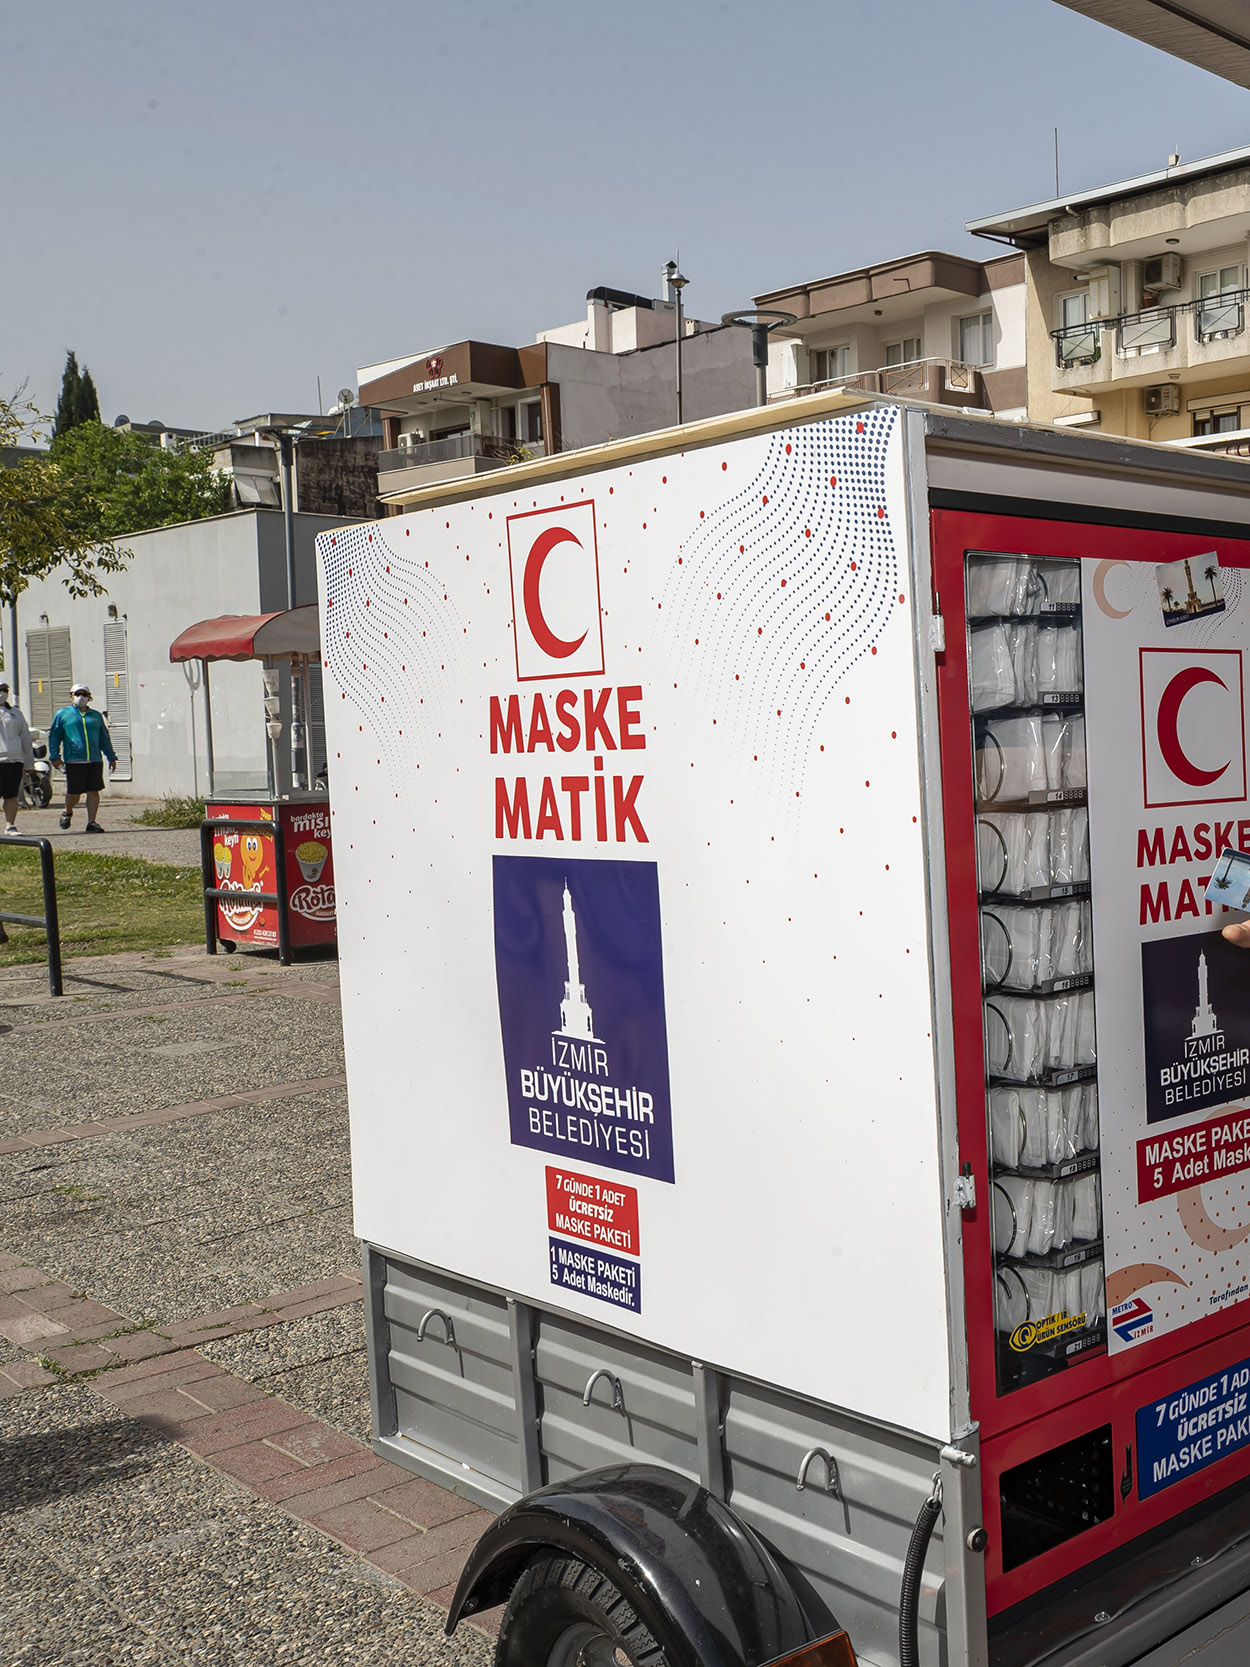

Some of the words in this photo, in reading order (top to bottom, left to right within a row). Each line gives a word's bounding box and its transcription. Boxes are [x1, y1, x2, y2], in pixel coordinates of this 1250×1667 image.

[490, 685, 646, 754] MASKE
[290, 812, 324, 822] bardakta
[495, 756, 649, 843] MATİK
[1139, 875, 1241, 926] MAT
[551, 1036, 609, 1077] İZMİR
[1184, 1034, 1226, 1059] İZMİR
[1160, 1048, 1250, 1086] BÜYÜKŞEHİR
[520, 1065, 654, 1124] BÜYÜKŞEHİR
[1165, 1067, 1247, 1106] BELEDİYESİ
[528, 1106, 650, 1160] BELEDİYESİ
[1145, 1130, 1207, 1167] MASKE
[1153, 1167, 1163, 1189] 5
[1171, 1153, 1210, 1184] Adet
[555, 1174, 563, 1190] 7
[563, 1177, 594, 1199] GÜNDE
[594, 1184, 600, 1200] 1
[601, 1188, 626, 1207] ADET
[568, 1195, 614, 1223] ÜCRETSİZ
[555, 1213, 592, 1237] MASKE
[593, 1223, 631, 1249] PAKETİ
[550, 1245, 556, 1262] 1
[558, 1247, 595, 1275] MASKE
[597, 1259, 636, 1288] PAKETİ
[552, 1264, 559, 1280] 5
[562, 1267, 586, 1290] Adet
[587, 1275, 635, 1307] Maskedir.
[1112, 1301, 1133, 1316] METRO
[1209, 1284, 1249, 1306] Tarafından
[1036, 1313, 1056, 1329] OPTİK
[1056, 1312, 1086, 1334] SENSÖRÜ
[1133, 1325, 1154, 1340] İZMİR
[1156, 1403, 1167, 1427] 7
[1169, 1382, 1218, 1420] GÜNDE
[1220, 1374, 1228, 1396] 1
[1177, 1392, 1247, 1441] ÜCRETSİZ
[1153, 1434, 1213, 1483] MASKE
